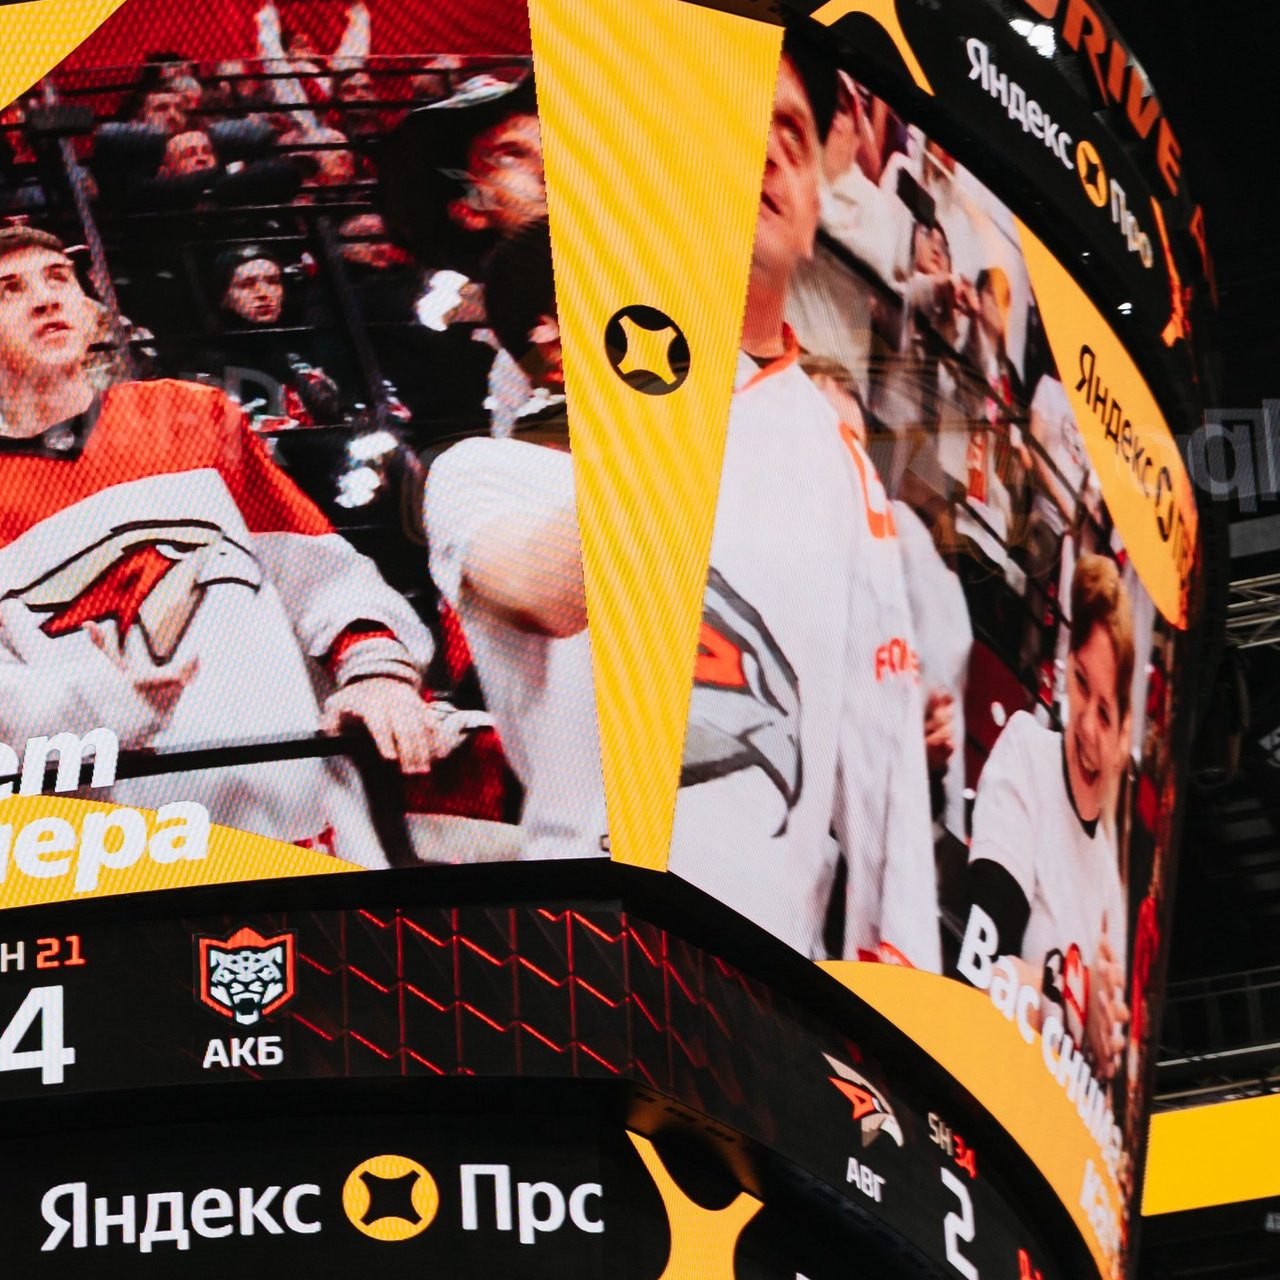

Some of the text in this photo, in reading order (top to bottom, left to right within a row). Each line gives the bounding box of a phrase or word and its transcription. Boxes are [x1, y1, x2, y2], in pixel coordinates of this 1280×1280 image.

[966, 37, 1074, 170] Яндекс
[1074, 343, 1153, 499] Яндекс
[36, 934, 87, 970] 21
[956, 903, 1042, 1045] Вас
[202, 1035, 284, 1069] АКБ
[846, 1156, 886, 1203] АВГ
[40, 1181, 322, 1254] Яндекс
